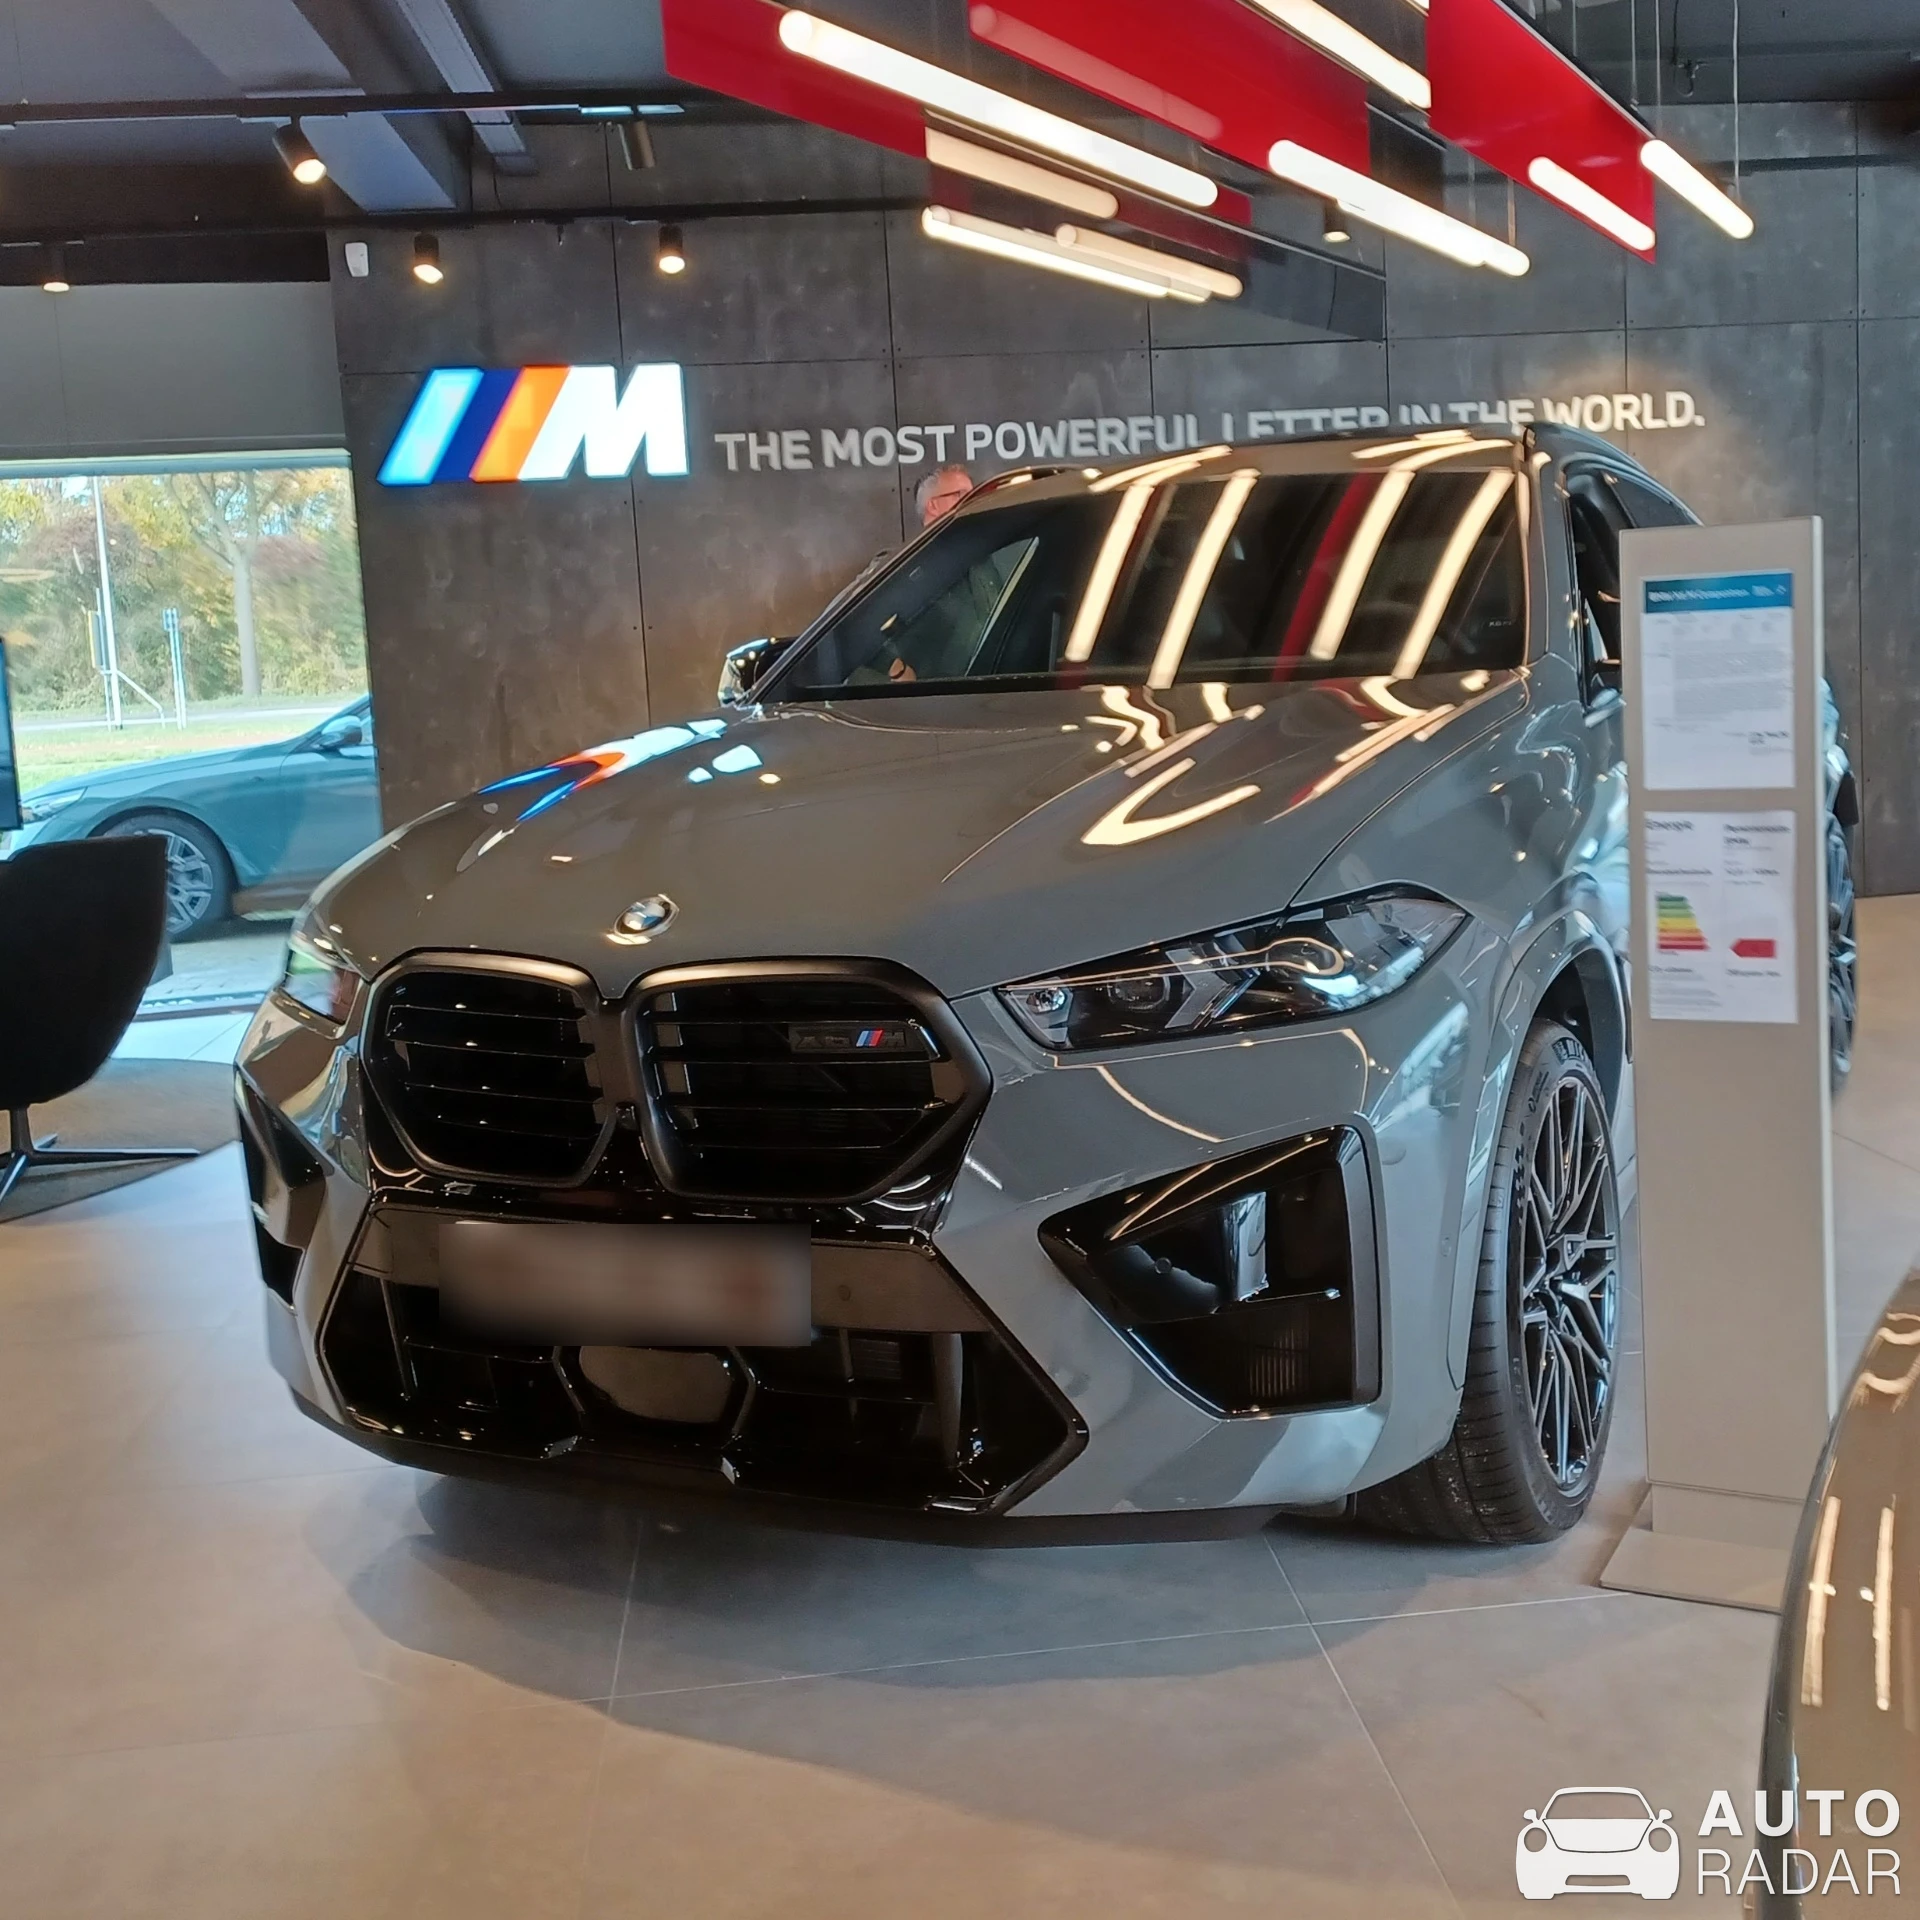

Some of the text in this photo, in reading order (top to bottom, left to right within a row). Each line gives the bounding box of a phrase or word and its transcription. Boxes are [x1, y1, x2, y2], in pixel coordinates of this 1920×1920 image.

[714, 429, 813, 471] THE
[821, 424, 955, 468] MOST
[965, 413, 1204, 460] POWERFUL
[1542, 391, 1706, 433] WORLD.
